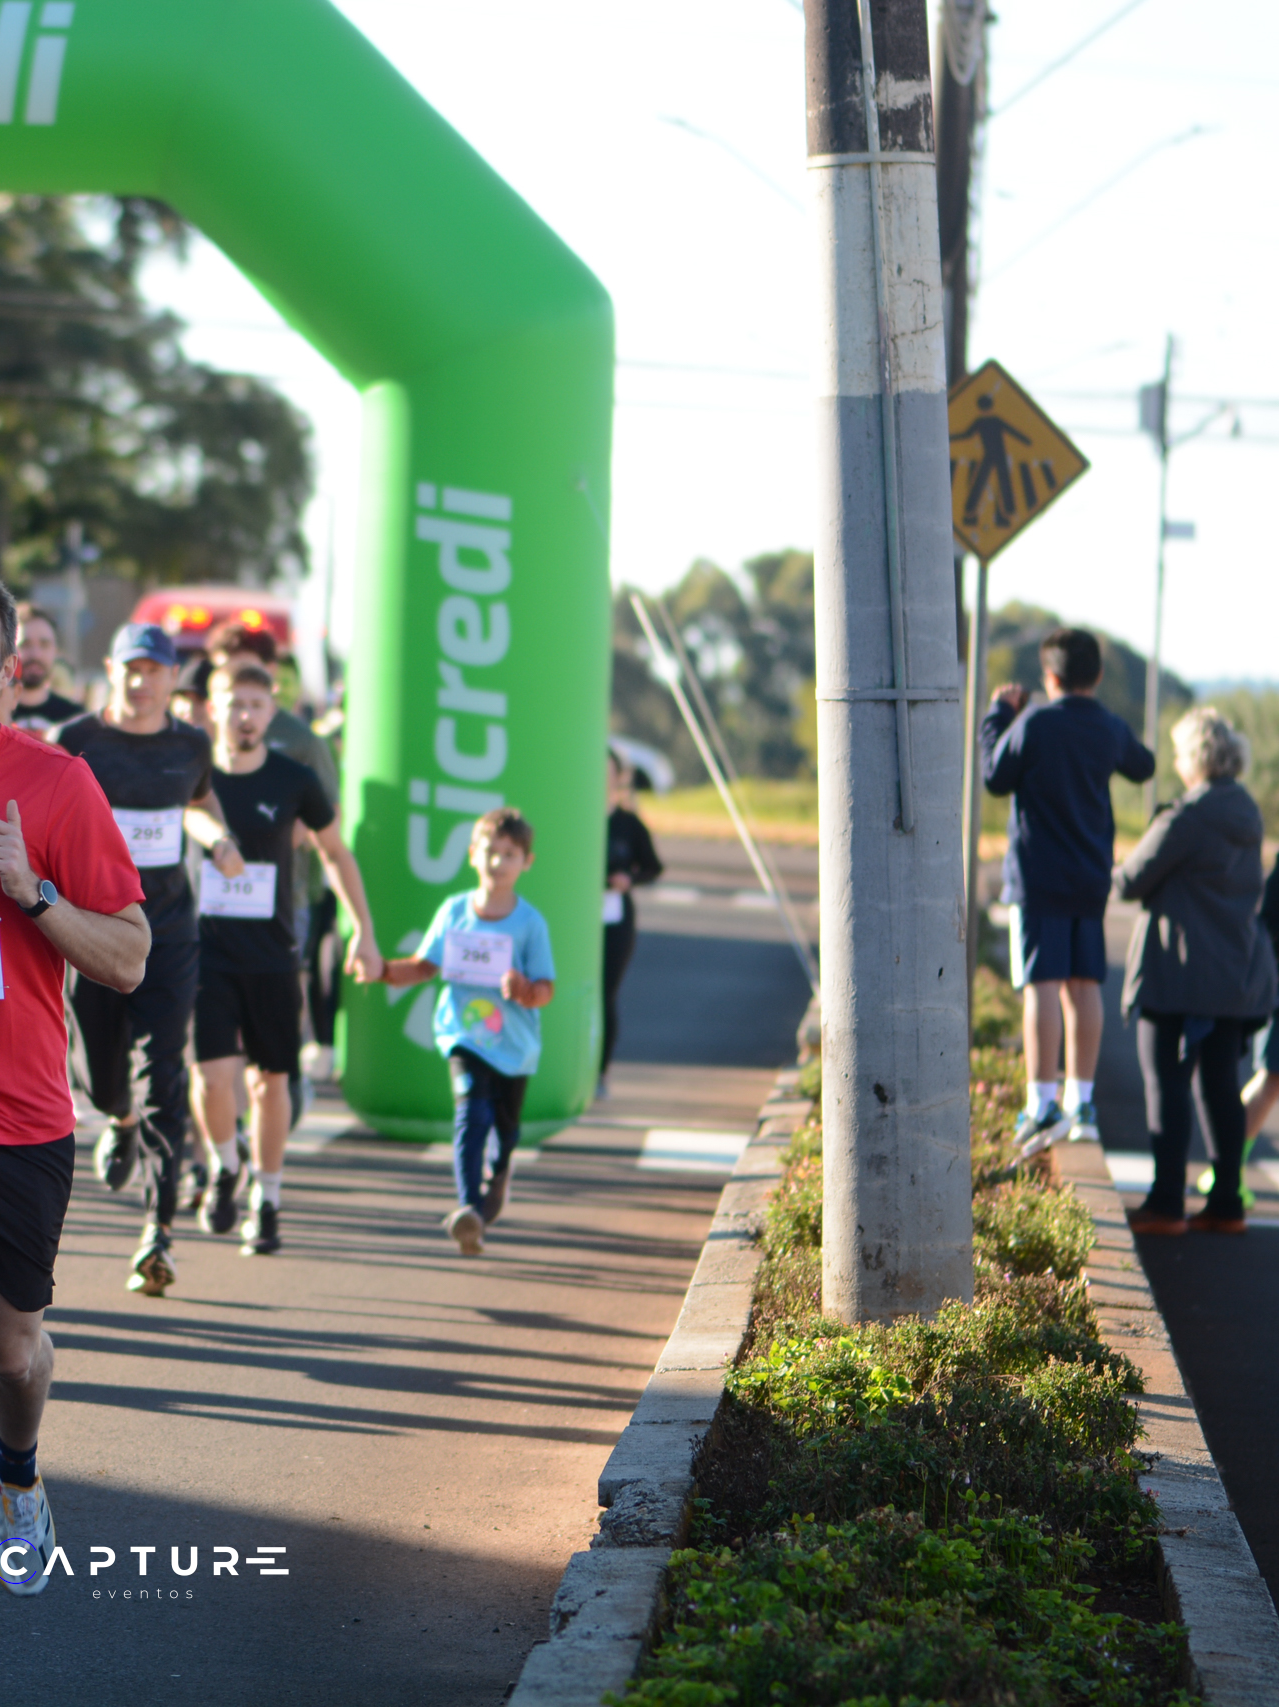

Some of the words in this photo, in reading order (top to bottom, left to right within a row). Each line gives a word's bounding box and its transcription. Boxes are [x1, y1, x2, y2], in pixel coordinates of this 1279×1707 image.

[407, 482, 513, 885] Sicredi
[131, 827, 164, 841] 295
[461, 948, 491, 965] 296
